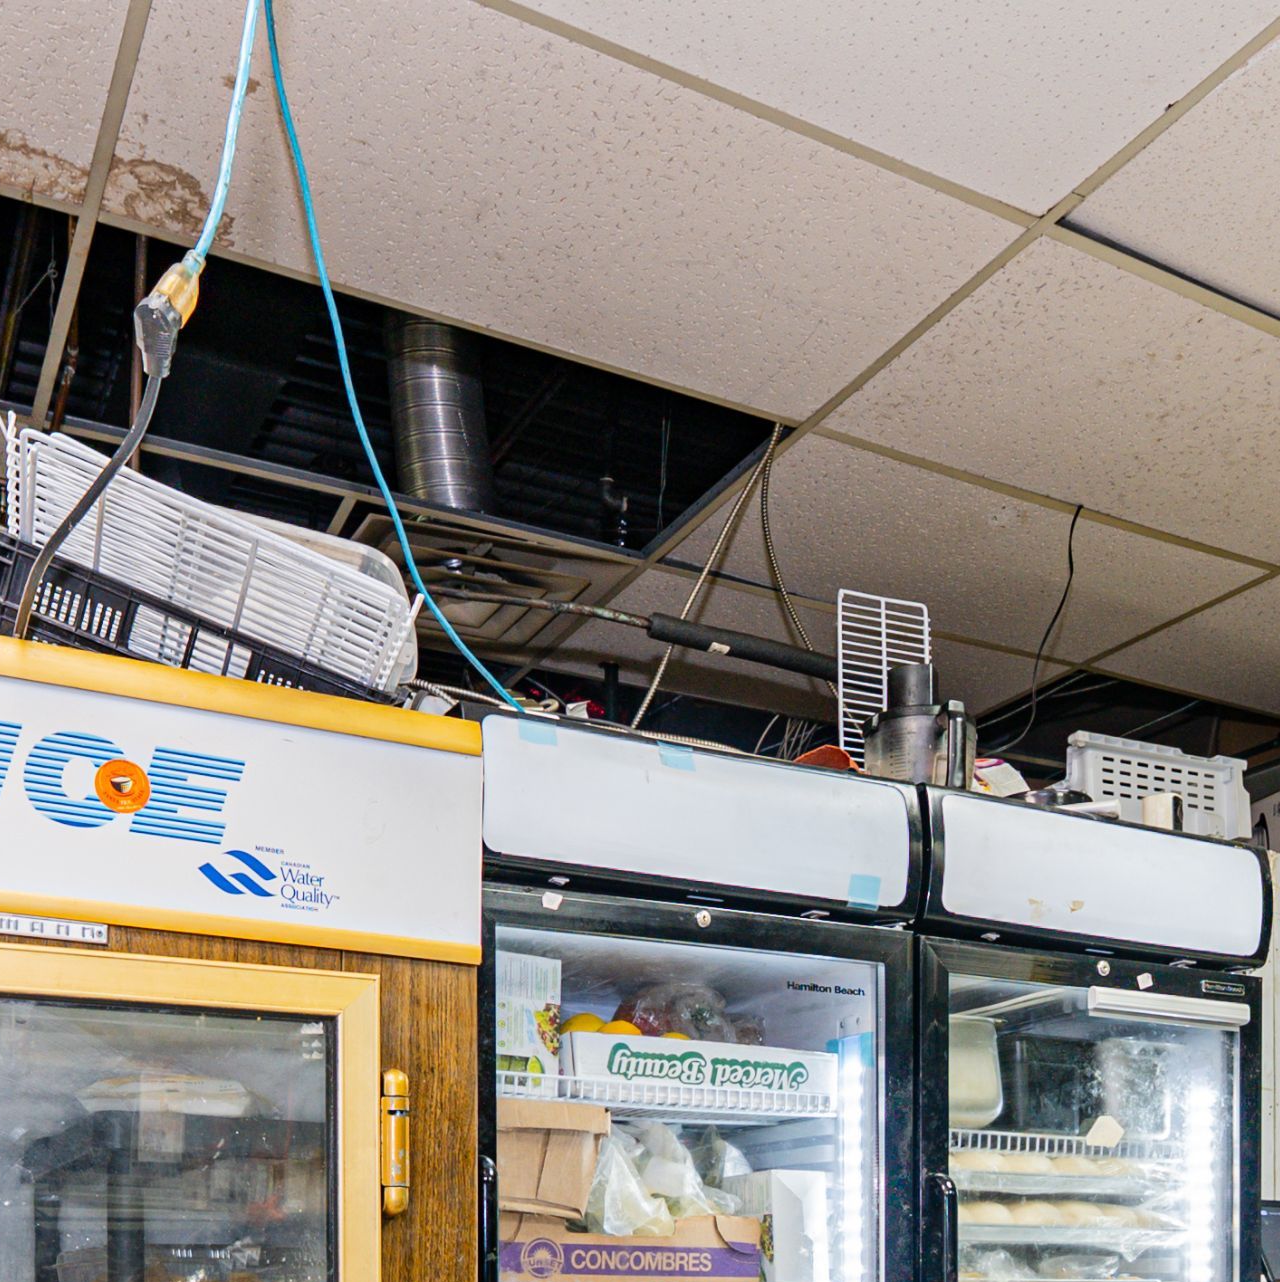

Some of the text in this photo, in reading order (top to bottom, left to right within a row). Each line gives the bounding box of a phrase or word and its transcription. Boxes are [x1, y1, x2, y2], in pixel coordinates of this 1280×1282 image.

[255, 845, 285, 855] MEMBER
[280, 866, 325, 887] Water
[786, 980, 866, 997] Hamilton Beach
[606, 1042, 809, 1091] Merced Beauty
[570, 1249, 713, 1272] CONCOMBRES
